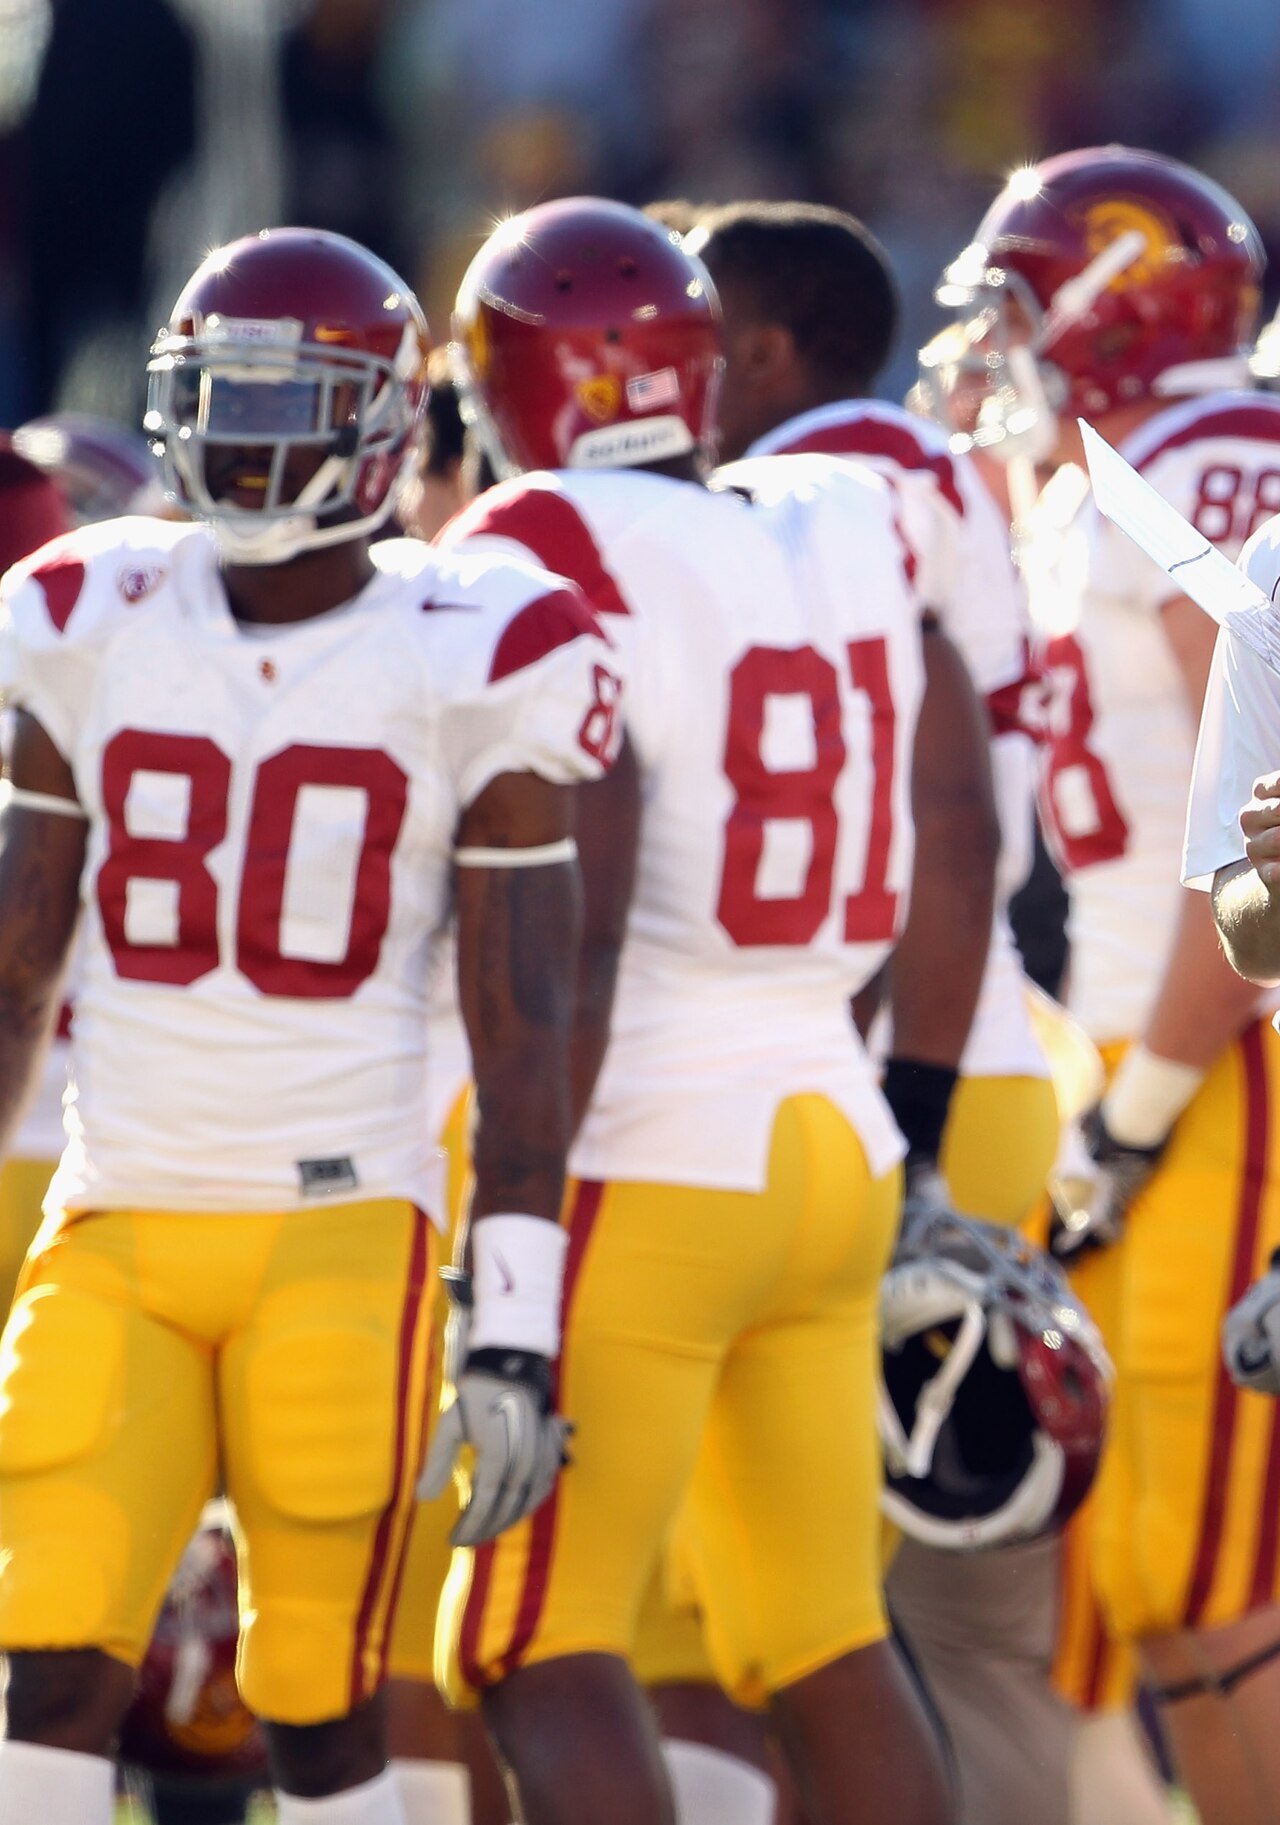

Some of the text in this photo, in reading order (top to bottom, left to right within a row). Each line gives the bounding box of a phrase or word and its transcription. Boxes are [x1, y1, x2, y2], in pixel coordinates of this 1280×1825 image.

[96, 728, 409, 998] 80
[717, 636, 900, 947] 81
[1046, 632, 1129, 868] 8
